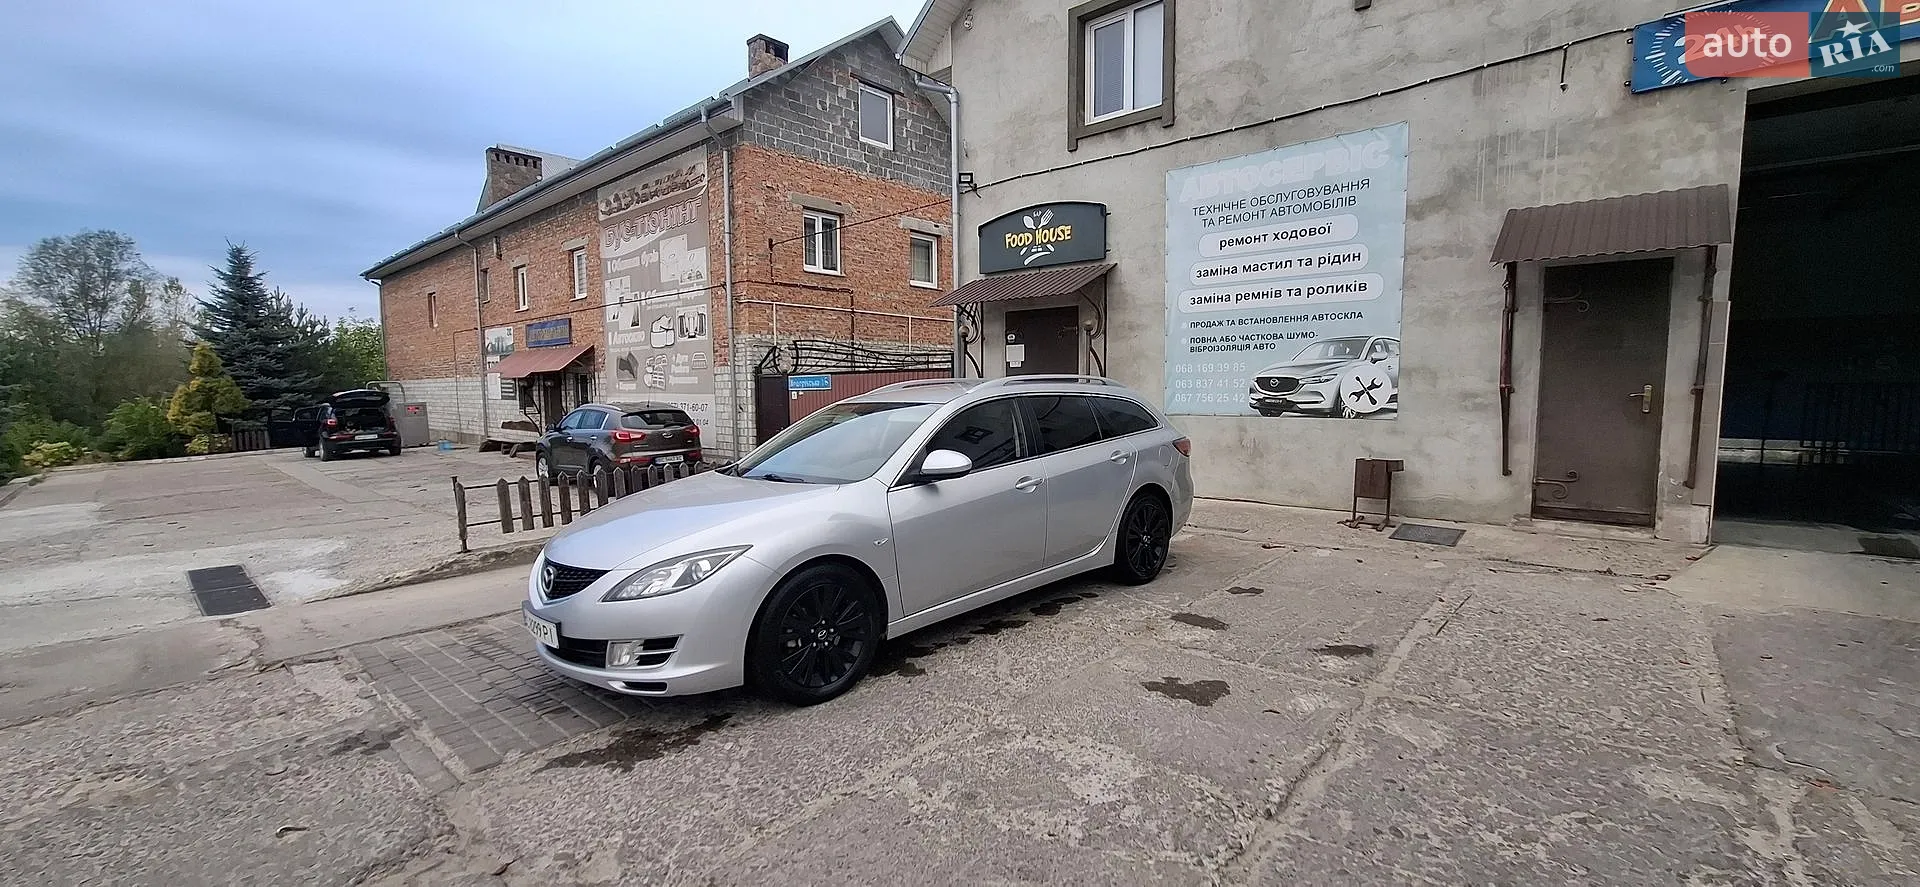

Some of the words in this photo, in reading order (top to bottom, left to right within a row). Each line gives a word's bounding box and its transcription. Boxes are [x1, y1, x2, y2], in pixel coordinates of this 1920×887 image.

[1179, 140, 1391, 202] АВТОСЕРВІС
[1192, 199, 1247, 216] ТЕХНІЧНЕ
[1250, 178, 1370, 207] ОБСЛУГОВУВАННЯ
[1201, 218, 1216, 228] ТА
[1218, 208, 1267, 225] РЕМОНТ
[1270, 195, 1357, 217] АВТОМОБІЛІВ
[1005, 232, 1033, 248] FOOD
[1035, 225, 1072, 246] HOUSE
[1219, 233, 1269, 251] ремонт
[1272, 222, 1333, 241] ходової
[1196, 264, 1238, 279] заміна
[1242, 259, 1293, 273] мастил
[1296, 257, 1313, 268] та
[1317, 252, 1362, 268] рідин
[1190, 292, 1231, 306] заміна
[1235, 287, 1283, 304] ремнів
[1286, 287, 1302, 297] та
[1306, 280, 1368, 298] роликів
[1190, 320, 1224, 329] ПРОДАЖ
[1238, 314, 1309, 326] ВСТАНОВЛЕННЯ
[1311, 311, 1364, 322] АВТОСКЛА
[1190, 336, 1217, 344] ПОВНА
[1219, 334, 1237, 343] АБО
[1239, 332, 1284, 342] ЧАСТКОВА
[1286, 331, 1319, 340] ШУМО-
[1190, 343, 1251, 353] ВІБРОІЗОЛЯЦІЯ
[1252, 342, 1276, 350] АВТО
[1175, 379, 1193, 389] 063
[1195, 379, 1214, 388] 837
[1233, 378, 1245, 388] 52
[1216, 393, 1229, 403] 25
[1232, 393, 1245, 403] 42
